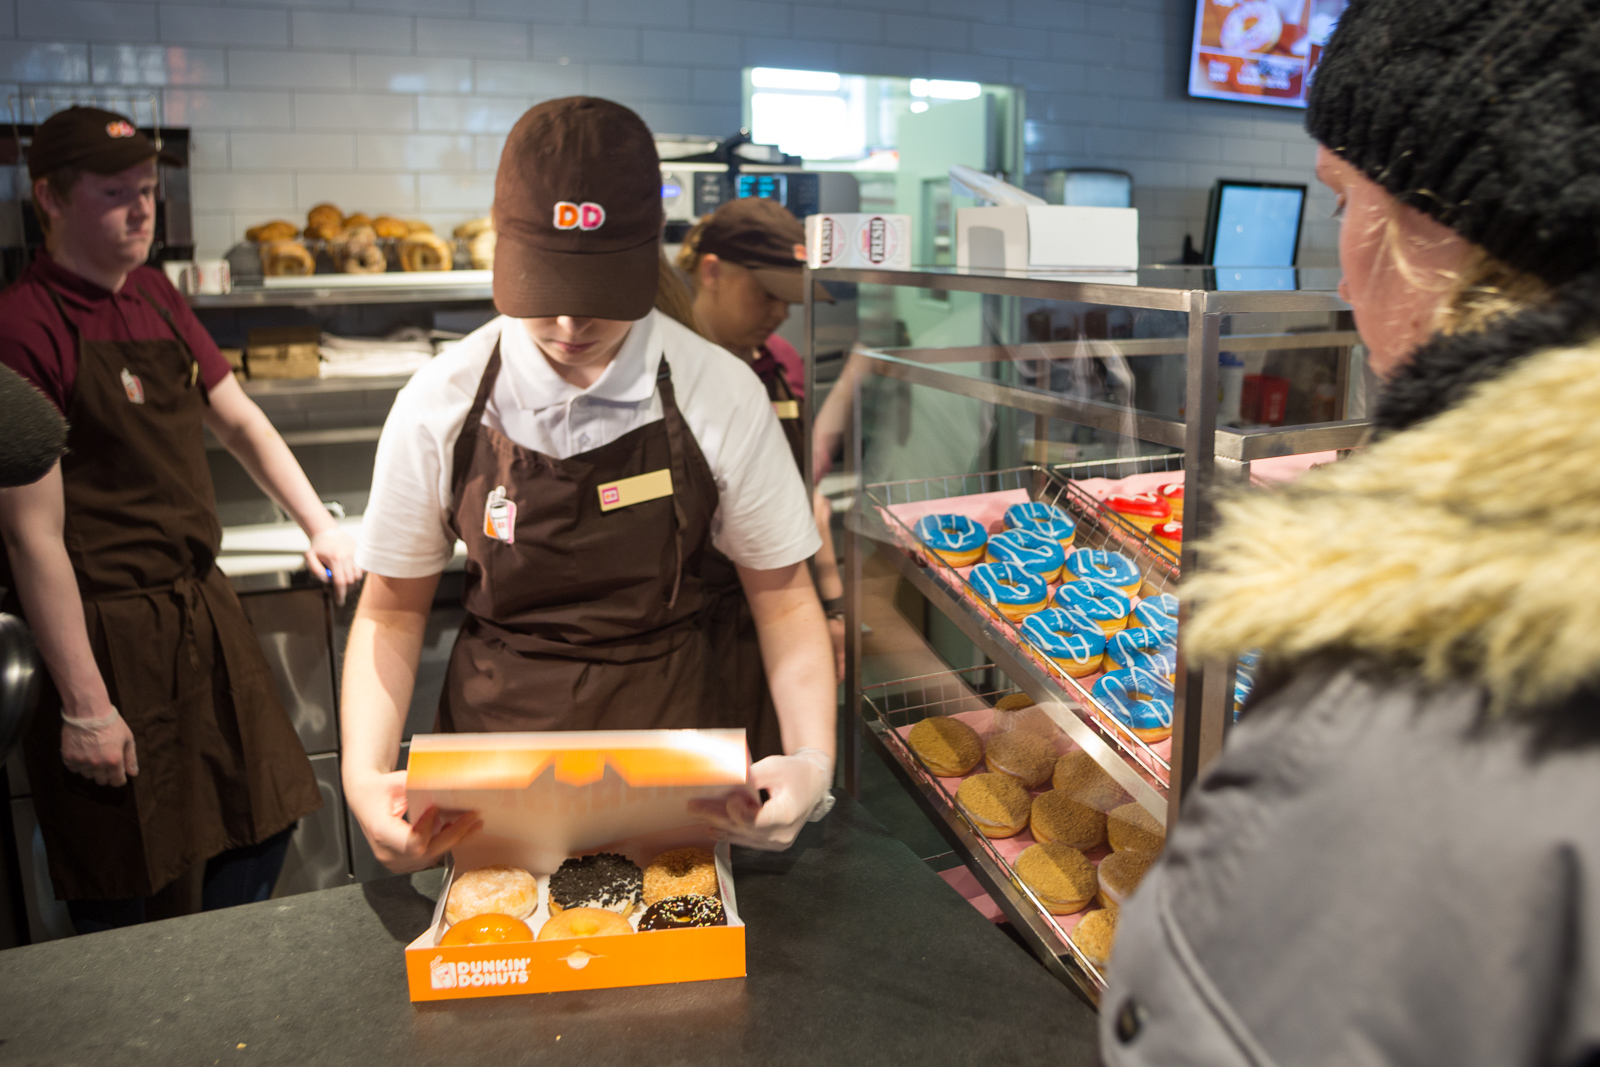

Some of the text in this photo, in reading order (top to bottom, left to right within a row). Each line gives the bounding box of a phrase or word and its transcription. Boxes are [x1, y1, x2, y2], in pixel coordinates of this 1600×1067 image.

[555, 202, 605, 230] DD
[871, 219, 885, 261] FRESH
[457, 957, 531, 975] DUNKIN'
[458, 970, 529, 988] DONUTS
